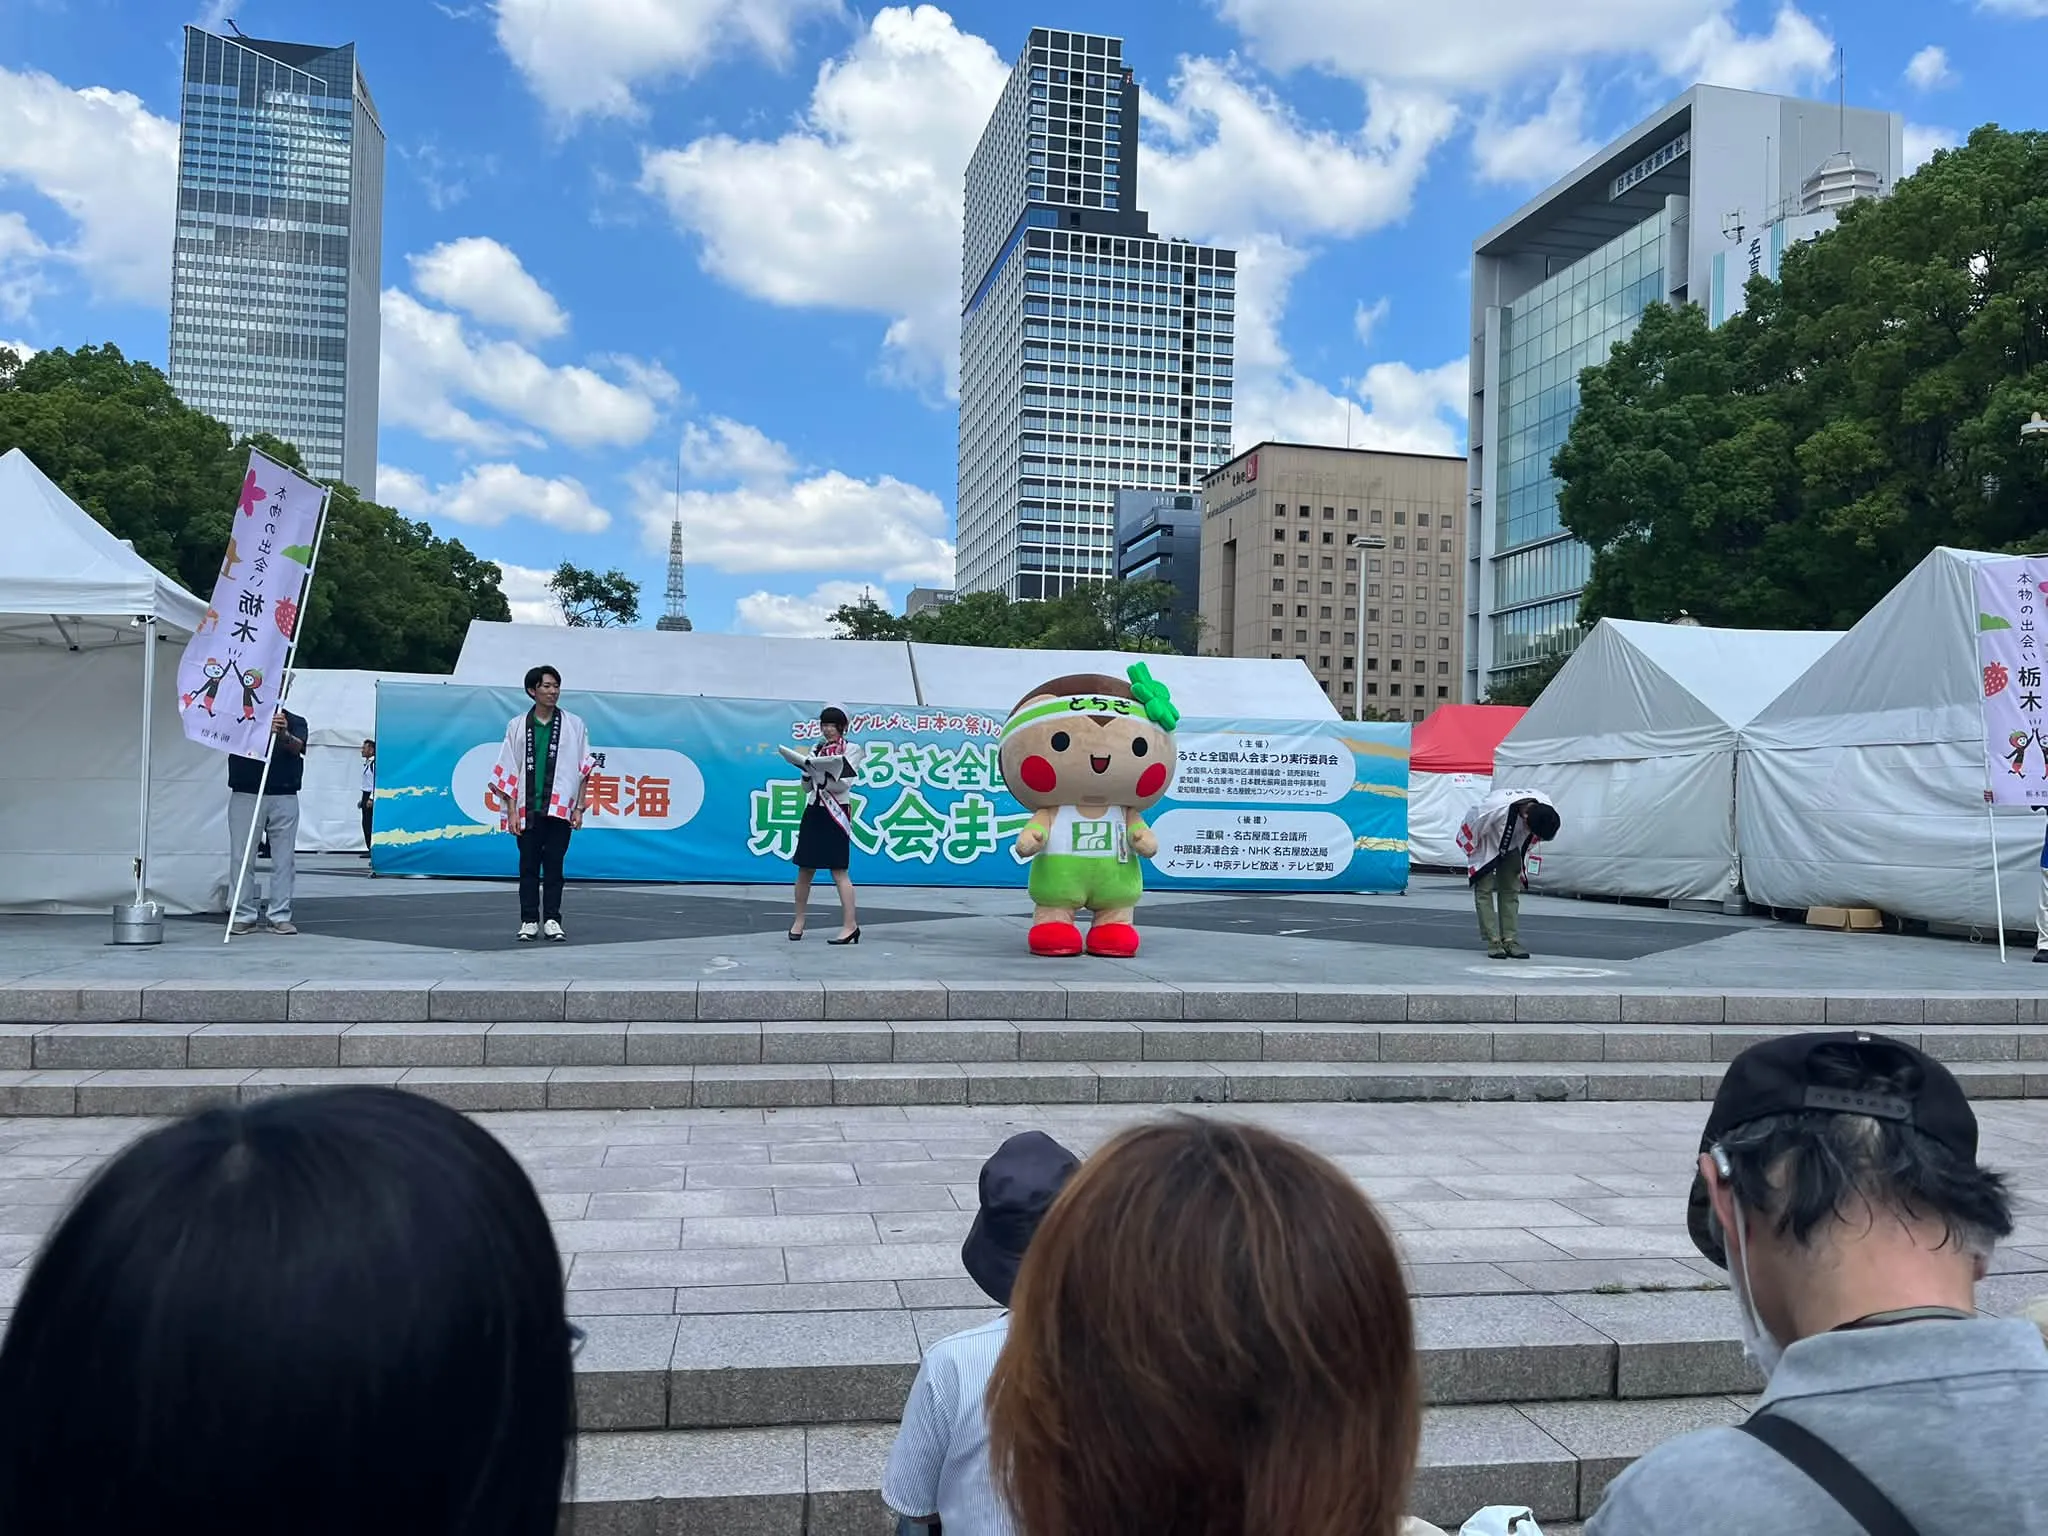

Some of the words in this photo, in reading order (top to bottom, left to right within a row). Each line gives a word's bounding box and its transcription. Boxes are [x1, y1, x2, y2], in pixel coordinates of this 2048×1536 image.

[1617, 138, 1686, 193] 日本経済新聞社
[1233, 472, 1246, 487] the
[2017, 573, 2037, 661] 本物の出会い
[2018, 666, 2042, 712] 栃木
[1069, 697, 1131, 715] とちぎ
[858, 747, 1004, 787] るさと全
[1177, 751, 1338, 765] るさと全国県人会まつり実行委員会
[1196, 830, 1308, 842] 三重県・名古屋商工会議所
[1272, 846, 1329, 857] 名古屋放送局
